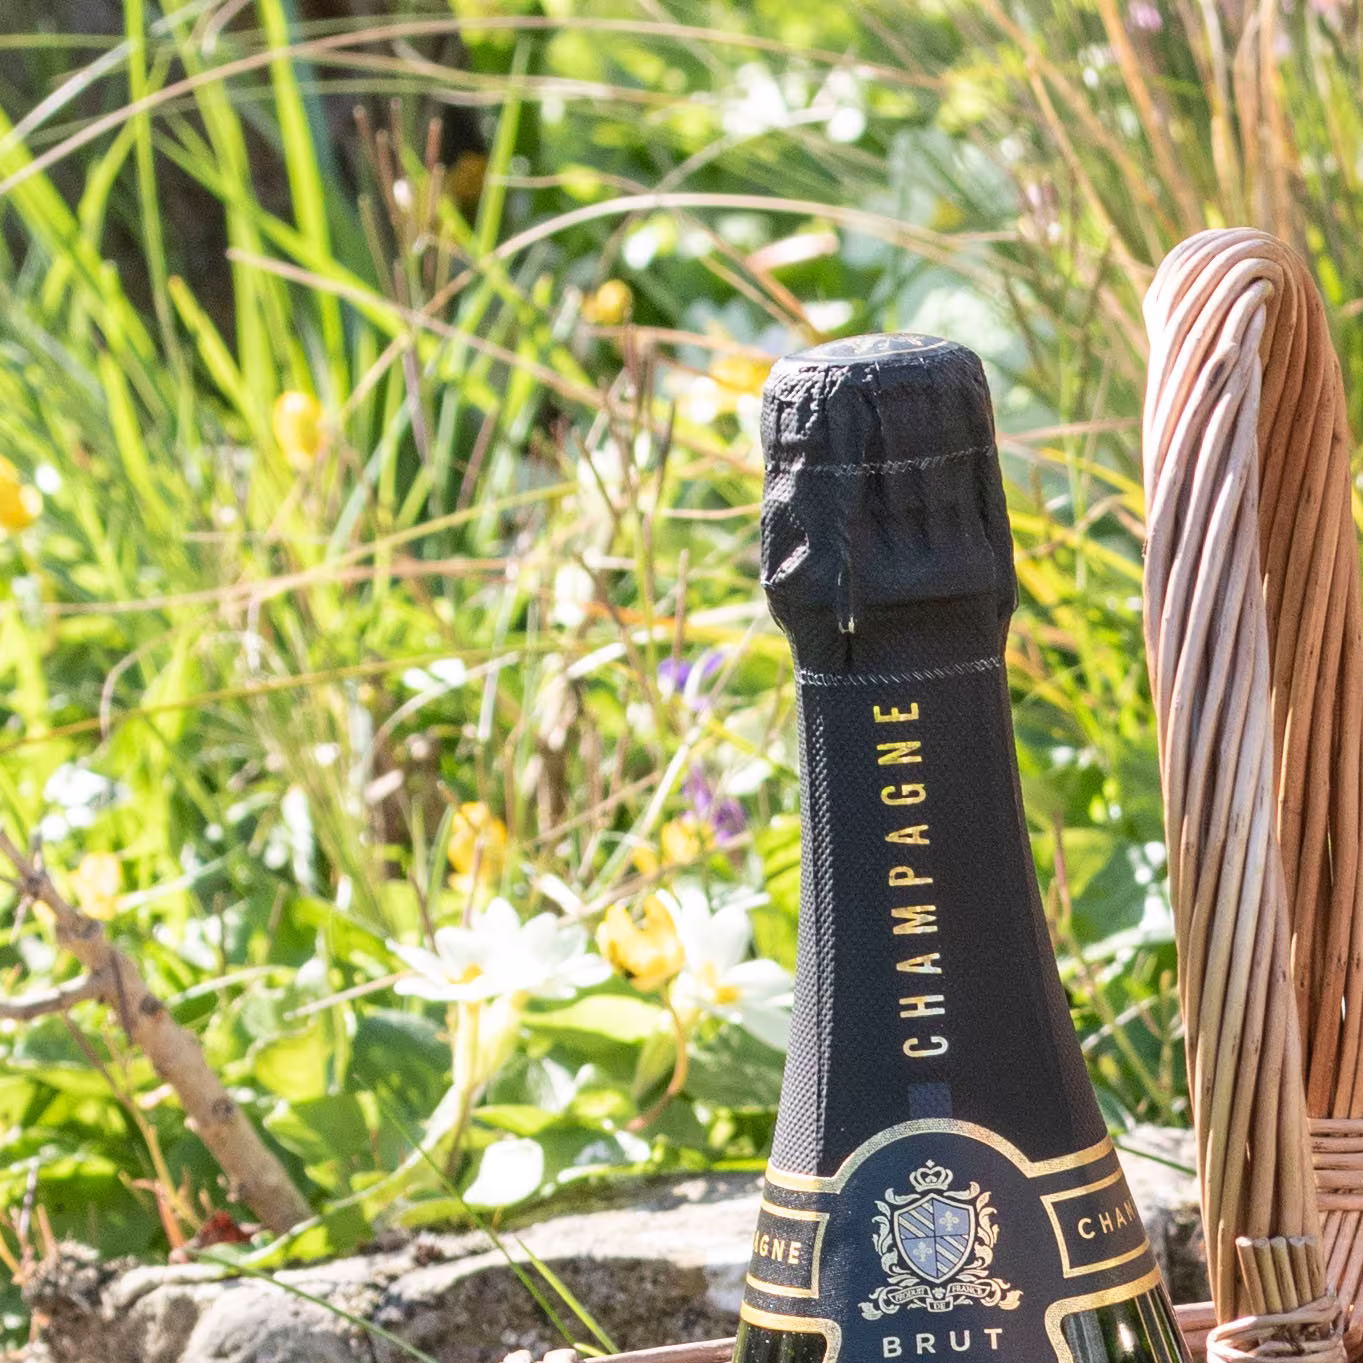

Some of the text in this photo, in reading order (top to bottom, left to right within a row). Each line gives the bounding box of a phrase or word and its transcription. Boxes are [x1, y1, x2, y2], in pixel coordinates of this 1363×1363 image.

[873, 702, 949, 1058] CHAMPAGNE
[933, 1302, 946, 1311] DE
[883, 1327, 1004, 1358] BRUT
